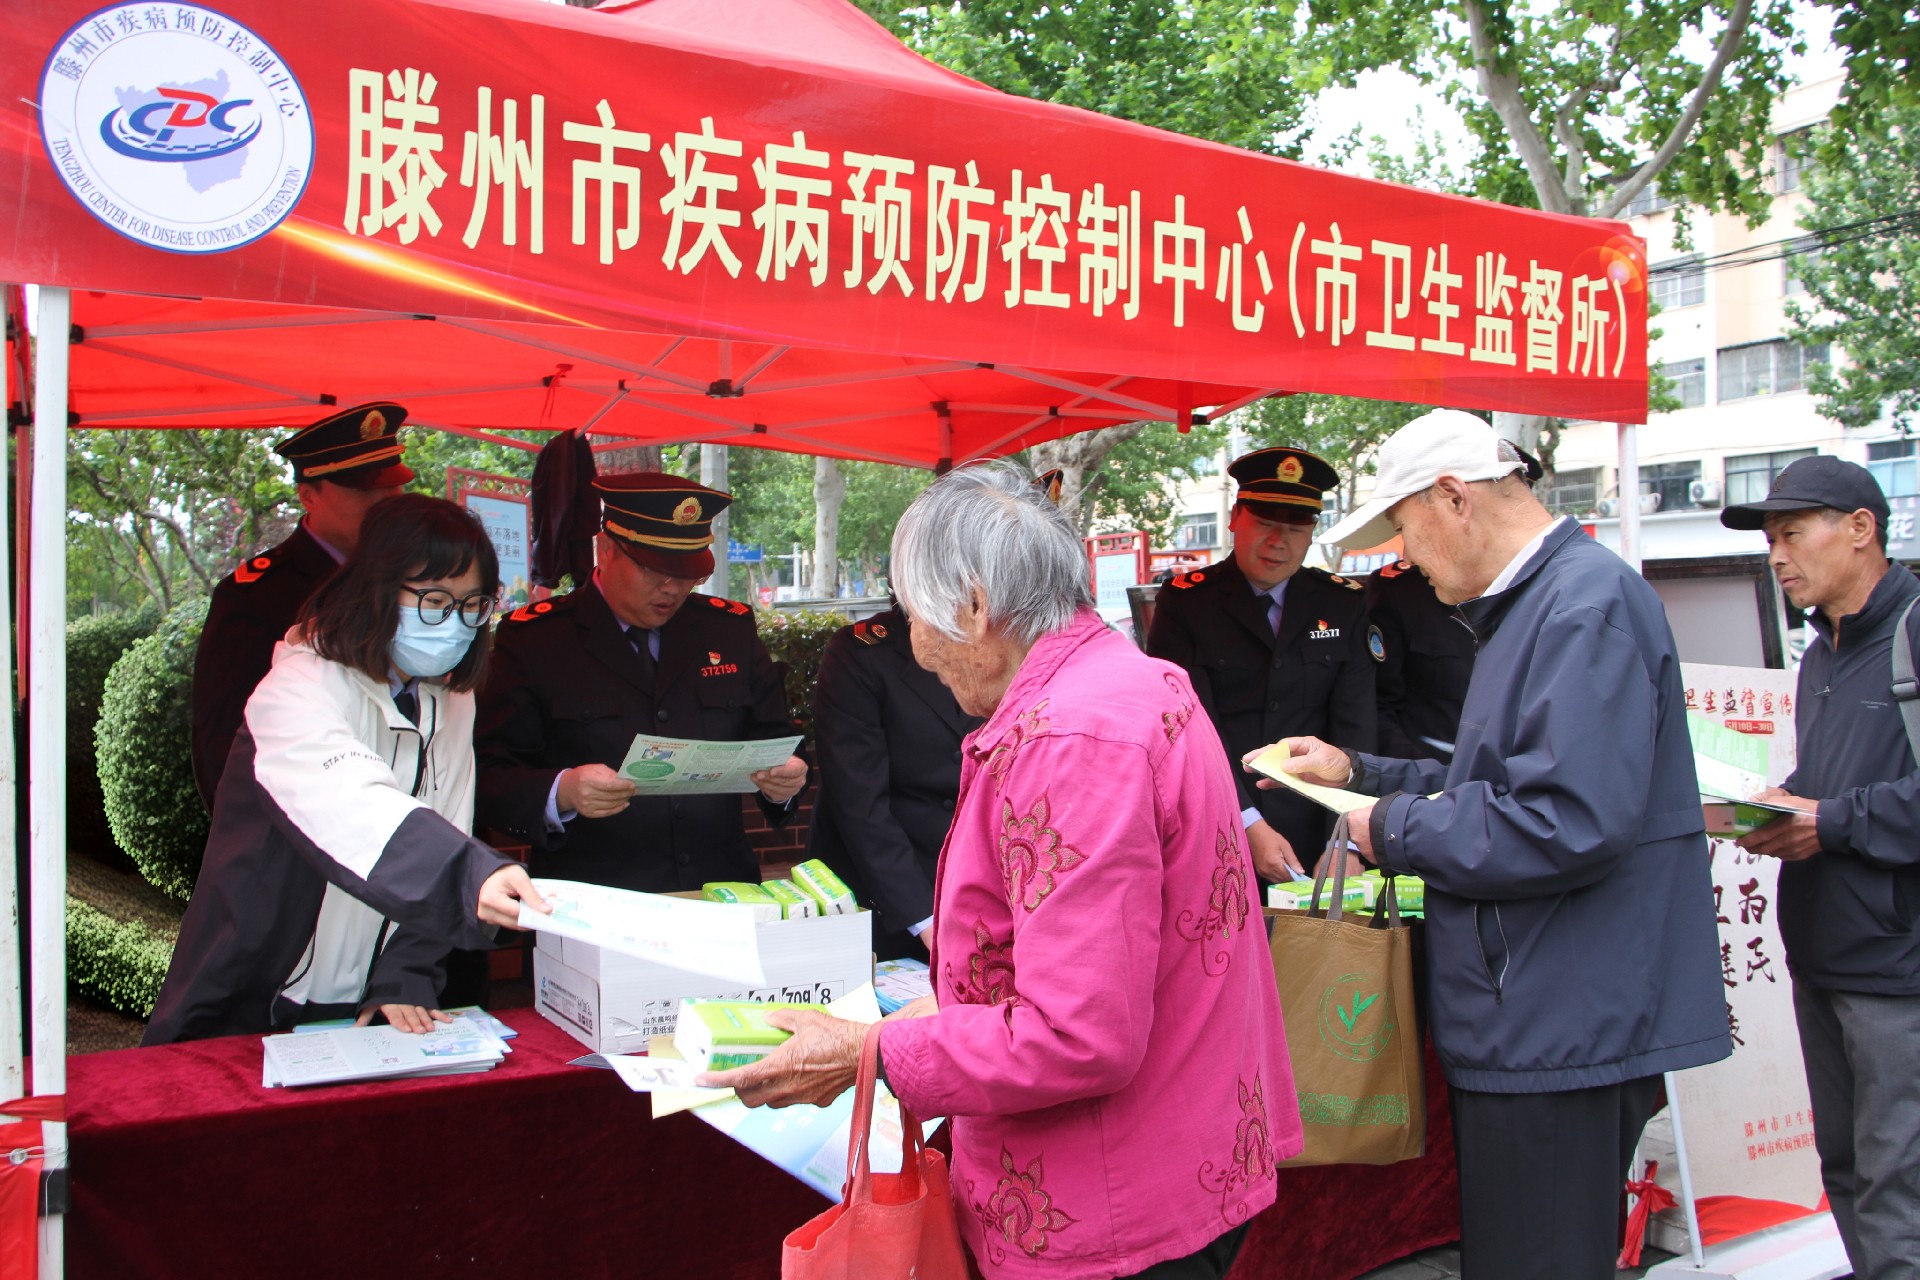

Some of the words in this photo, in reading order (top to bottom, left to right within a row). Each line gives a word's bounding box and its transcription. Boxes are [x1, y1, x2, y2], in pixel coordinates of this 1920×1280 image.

[52, 6, 301, 118] 滕州市疾病预防控制中心
[53, 137, 95, 200] TENGZHOU
[88, 188, 128, 225] CENTER
[126, 214, 152, 237] FOR
[151, 227, 197, 246] DISEASE
[196, 224, 246, 246] CONTROL
[243, 211, 267, 235] AND
[262, 165, 302, 222] PREVENTION
[1309, 628, 1339, 639] 372577
[701, 664, 738, 677] 372759
[1685, 687, 1793, 717] 卫生监督宣传
[323, 752, 346, 770] STAY
